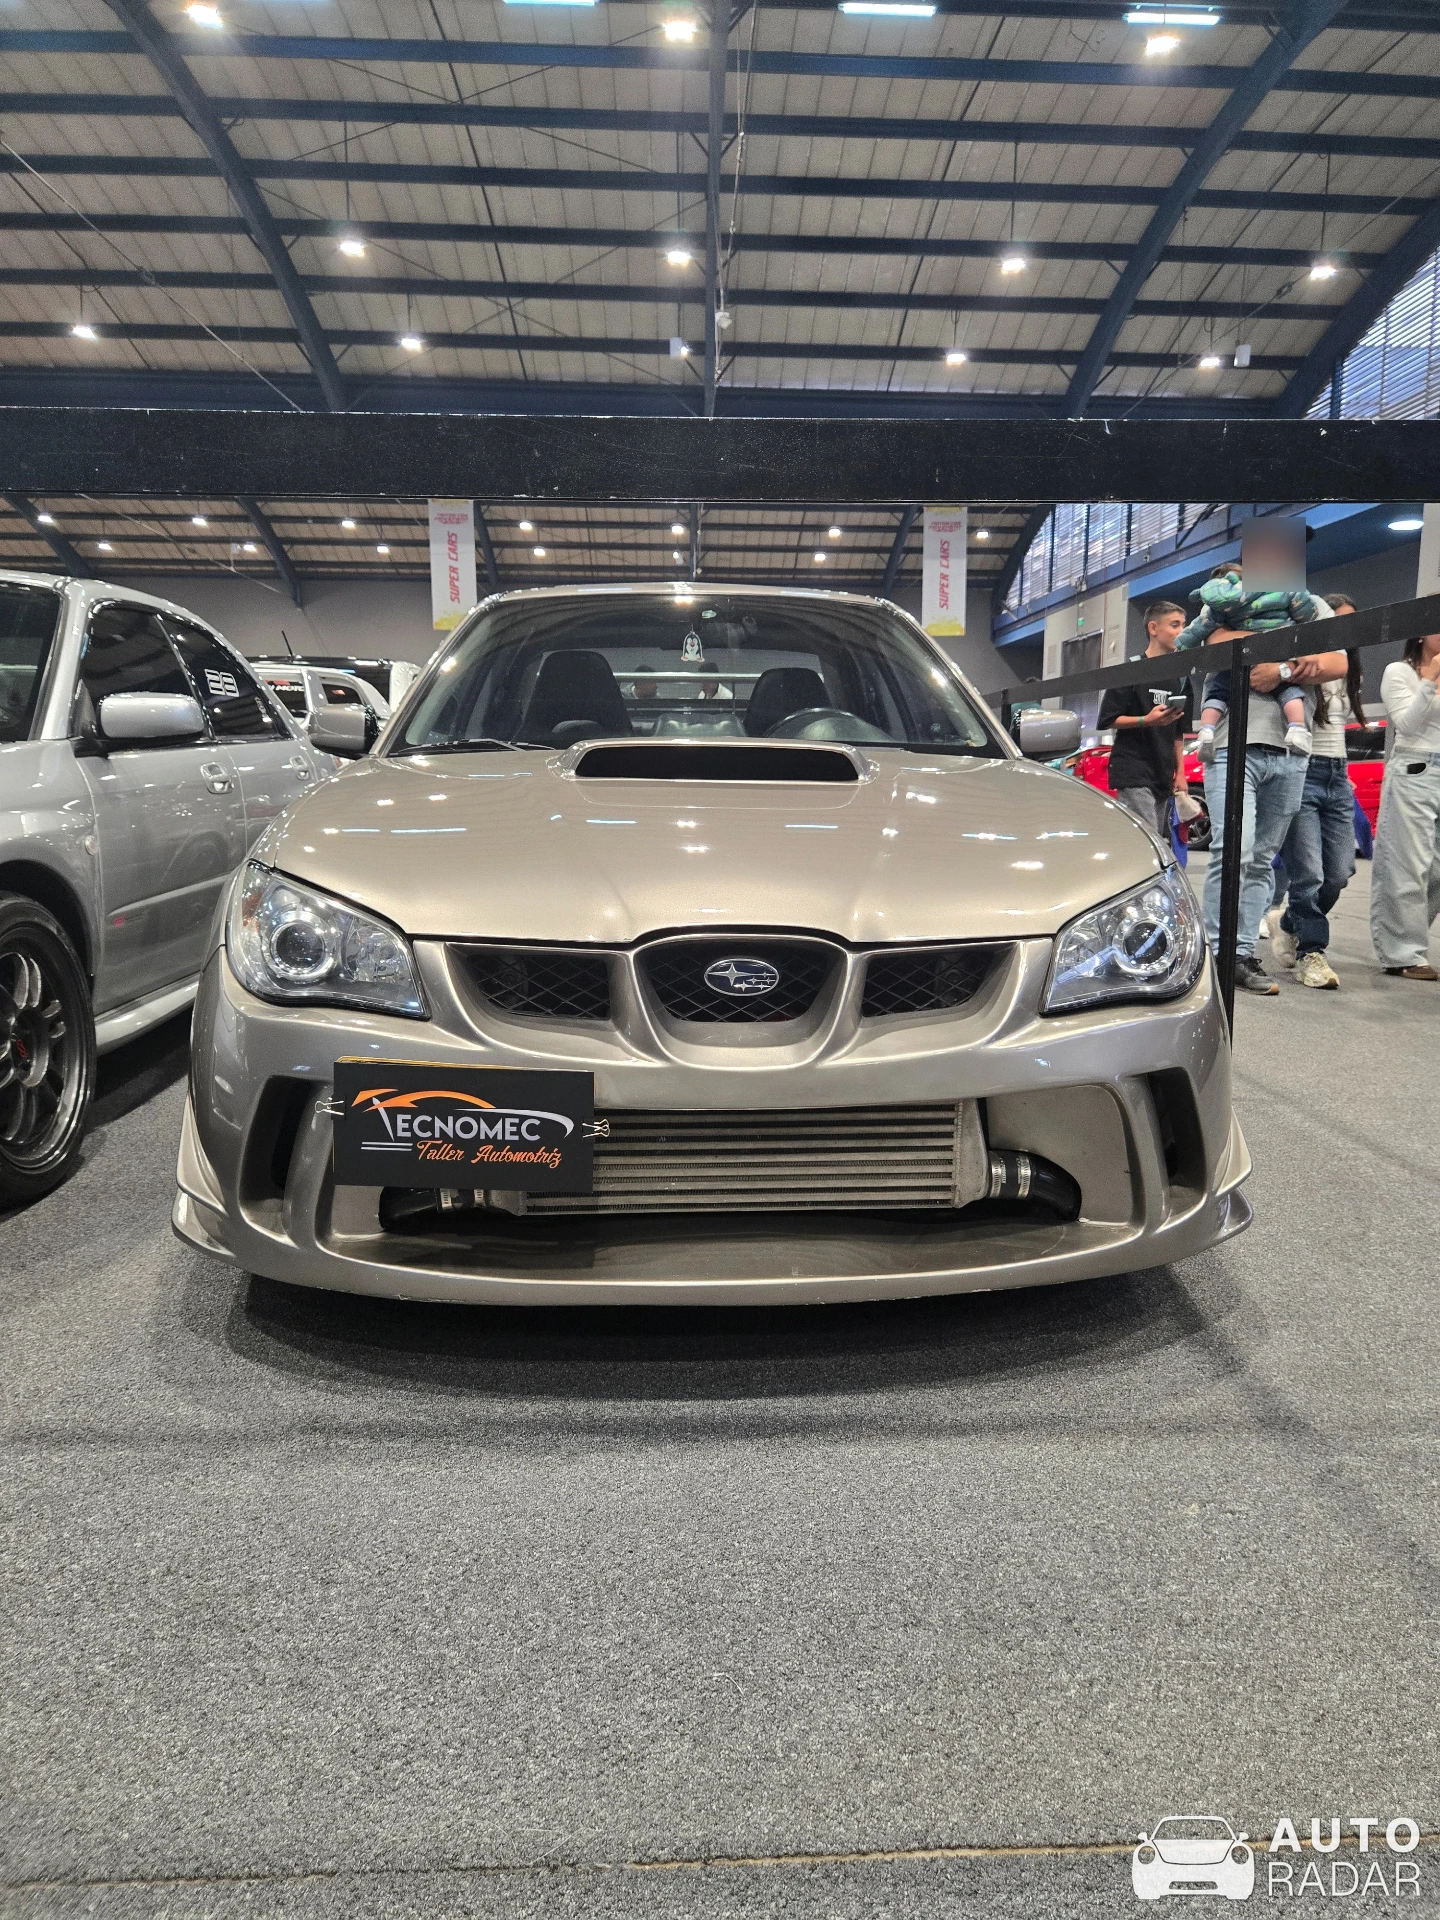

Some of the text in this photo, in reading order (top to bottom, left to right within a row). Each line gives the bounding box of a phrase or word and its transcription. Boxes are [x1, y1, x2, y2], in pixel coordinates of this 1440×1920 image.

[447, 531, 460, 604] SUPER CARS
[939, 539, 950, 610] SUPER CARS
[416, 1140, 562, 1169] Taller Automotriz
